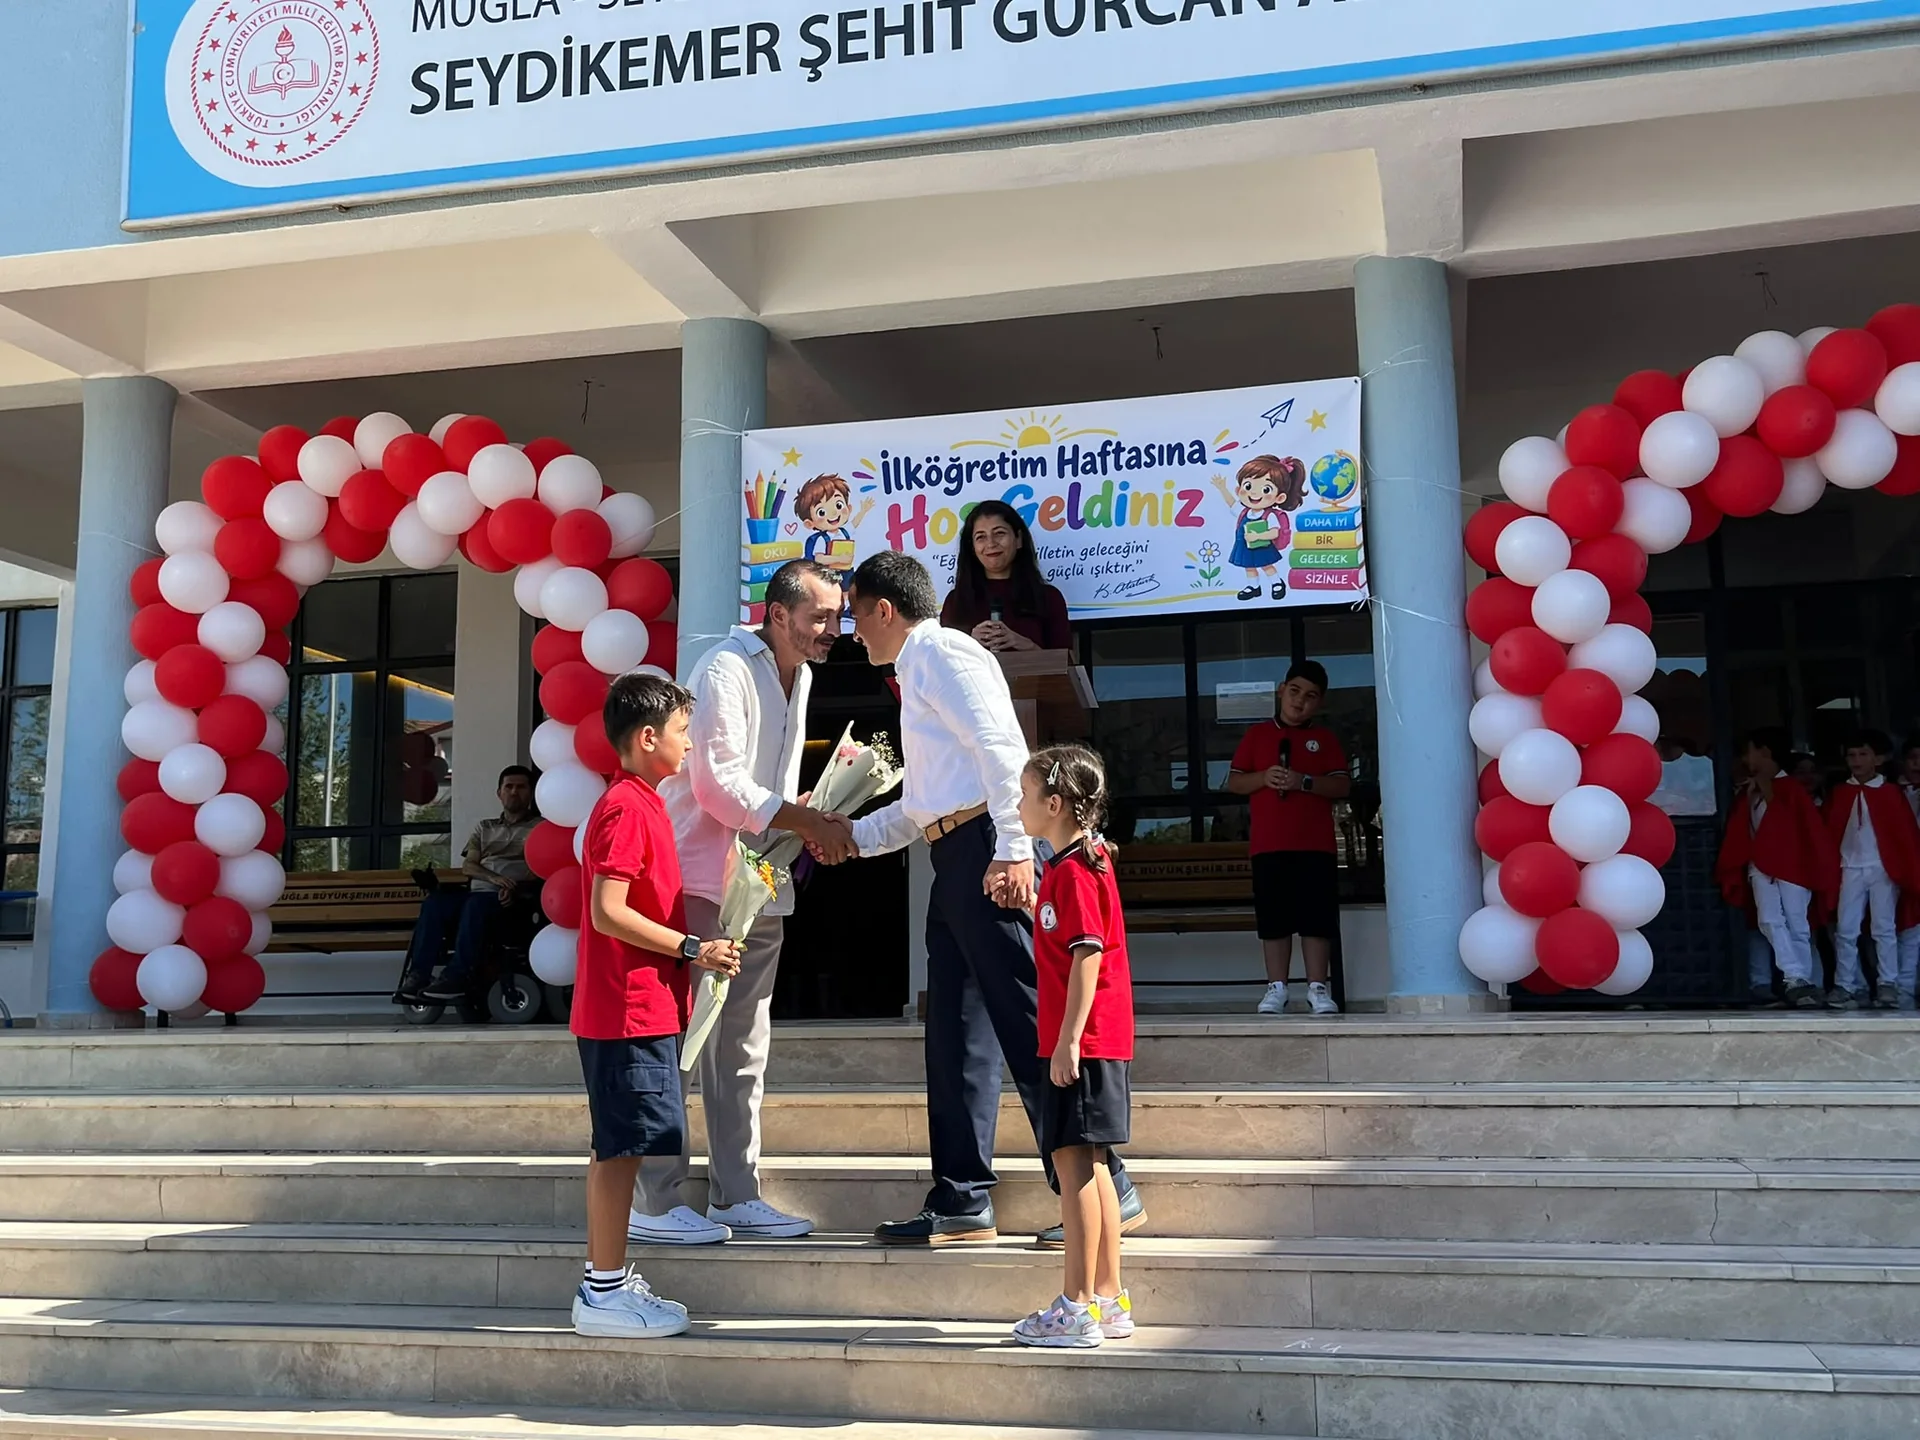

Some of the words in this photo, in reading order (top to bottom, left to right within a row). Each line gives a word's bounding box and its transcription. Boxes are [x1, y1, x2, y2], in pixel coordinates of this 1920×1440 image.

[410, 22, 782, 115] SEYDİKEMER
[881, 449, 1047, 496] İlköğretim
[1057, 439, 1206, 479] Haftasına
[885, 494, 976, 551] Ho
[1304, 518, 1332, 527] DAHA
[1335, 515, 1348, 527] İYİ
[1315, 533, 1333, 545] BİR
[764, 547, 787, 559] OKU
[1079, 539, 1150, 561] geleceğini
[1300, 554, 1348, 564] GELECEK
[1047, 560, 1084, 582] güçlü
[1305, 572, 1348, 584] SİZİNLE
